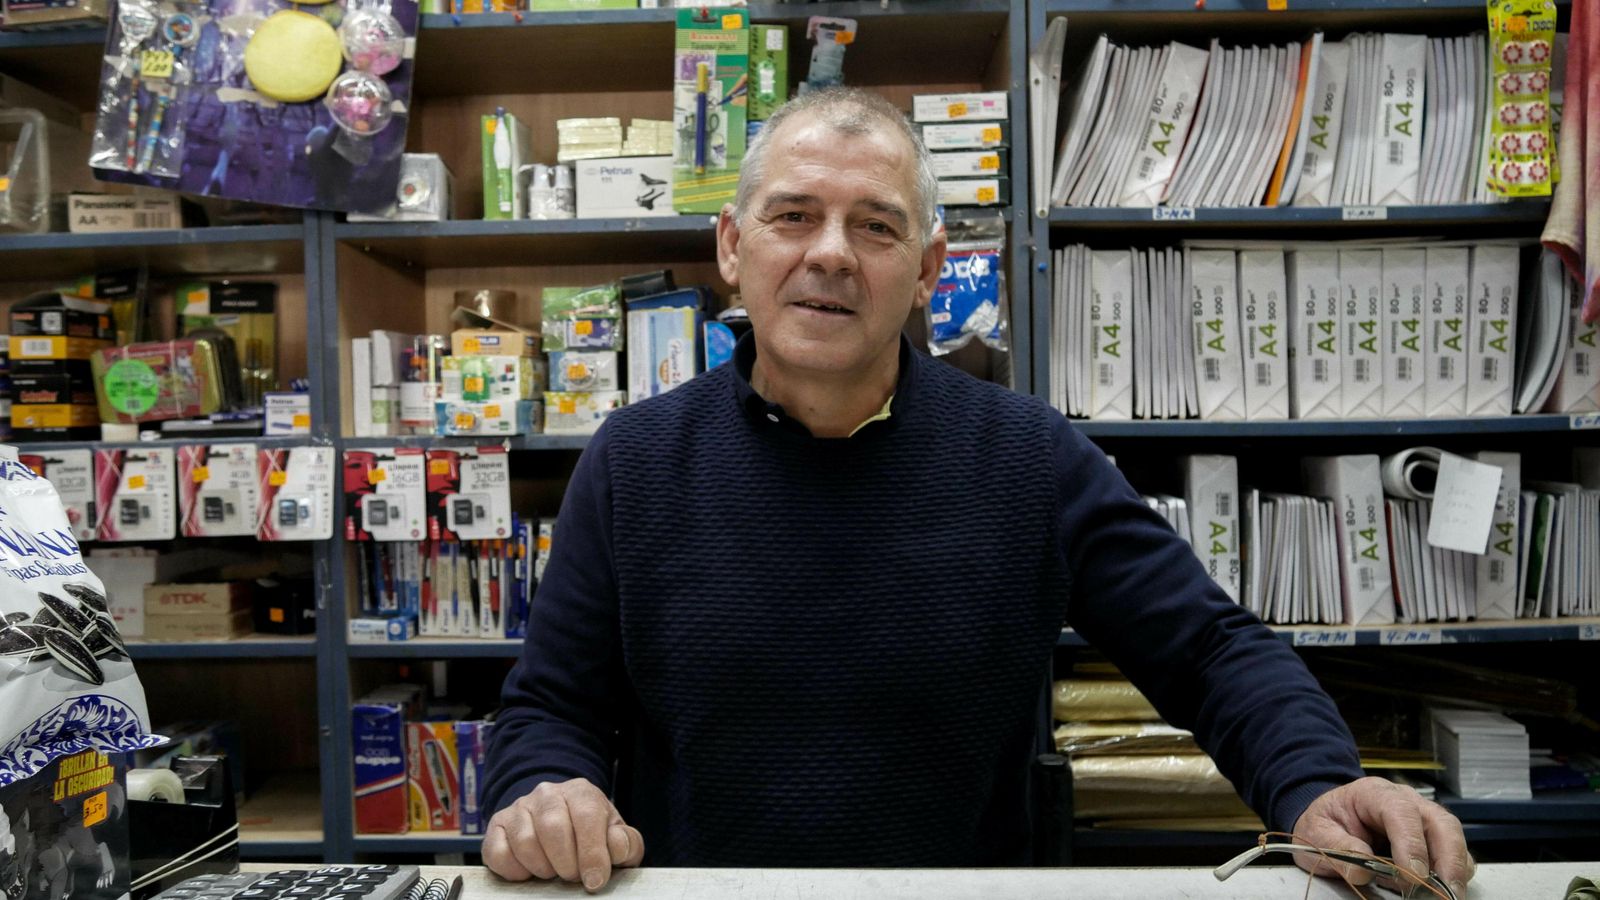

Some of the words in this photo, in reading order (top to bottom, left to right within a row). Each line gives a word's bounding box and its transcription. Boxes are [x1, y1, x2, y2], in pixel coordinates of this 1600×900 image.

[1310, 114, 1330, 149] A4
[1394, 101, 1414, 137] A4
[1152, 120, 1176, 157] A4
[600, 166, 633, 175] Petrus
[74, 200, 136, 210] Panasonic
[78, 215, 98, 225] AA
[1102, 323, 1121, 358] A4
[1206, 318, 1226, 352] A4
[1258, 323, 1278, 358] A4
[1317, 319, 1336, 354] A4
[1358, 319, 1377, 354] A4
[1401, 317, 1421, 352] A4
[1443, 317, 1463, 352] A4
[1488, 319, 1509, 352] A4
[474, 472, 506, 484] 32GB
[1209, 520, 1228, 556] A4
[1359, 527, 1379, 561] A4
[1494, 520, 1515, 555] A4
[169, 592, 207, 605] TDK
[54, 779, 65, 801] LA
[68, 766, 114, 797] OSCURIDAD!
